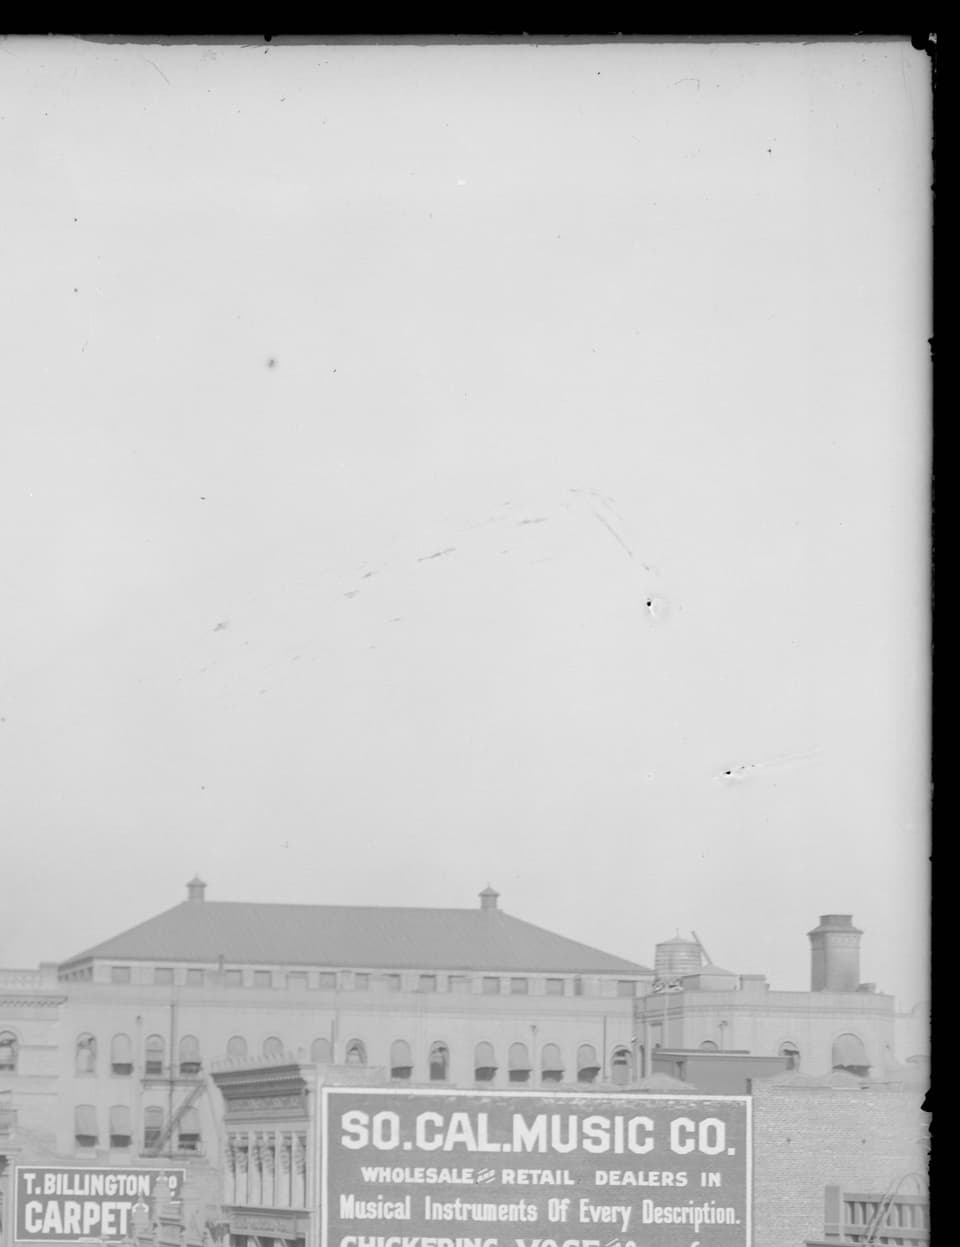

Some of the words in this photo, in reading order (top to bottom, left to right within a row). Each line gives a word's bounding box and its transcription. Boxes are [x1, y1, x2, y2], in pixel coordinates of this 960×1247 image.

[671, 1118, 736, 1156] CO.
[361, 1166, 474, 1184] WHOLESALE
[502, 1169, 575, 1185] RETAIL
[596, 1171, 688, 1187] DEALERS
[701, 1172, 721, 1187] IN
[340, 1194, 411, 1220] Musical
[425, 1196, 538, 1222] Instruments
[548, 1198, 571, 1222] Of
[580, 1199, 632, 1232] Every
[642, 1200, 740, 1232] Description.
